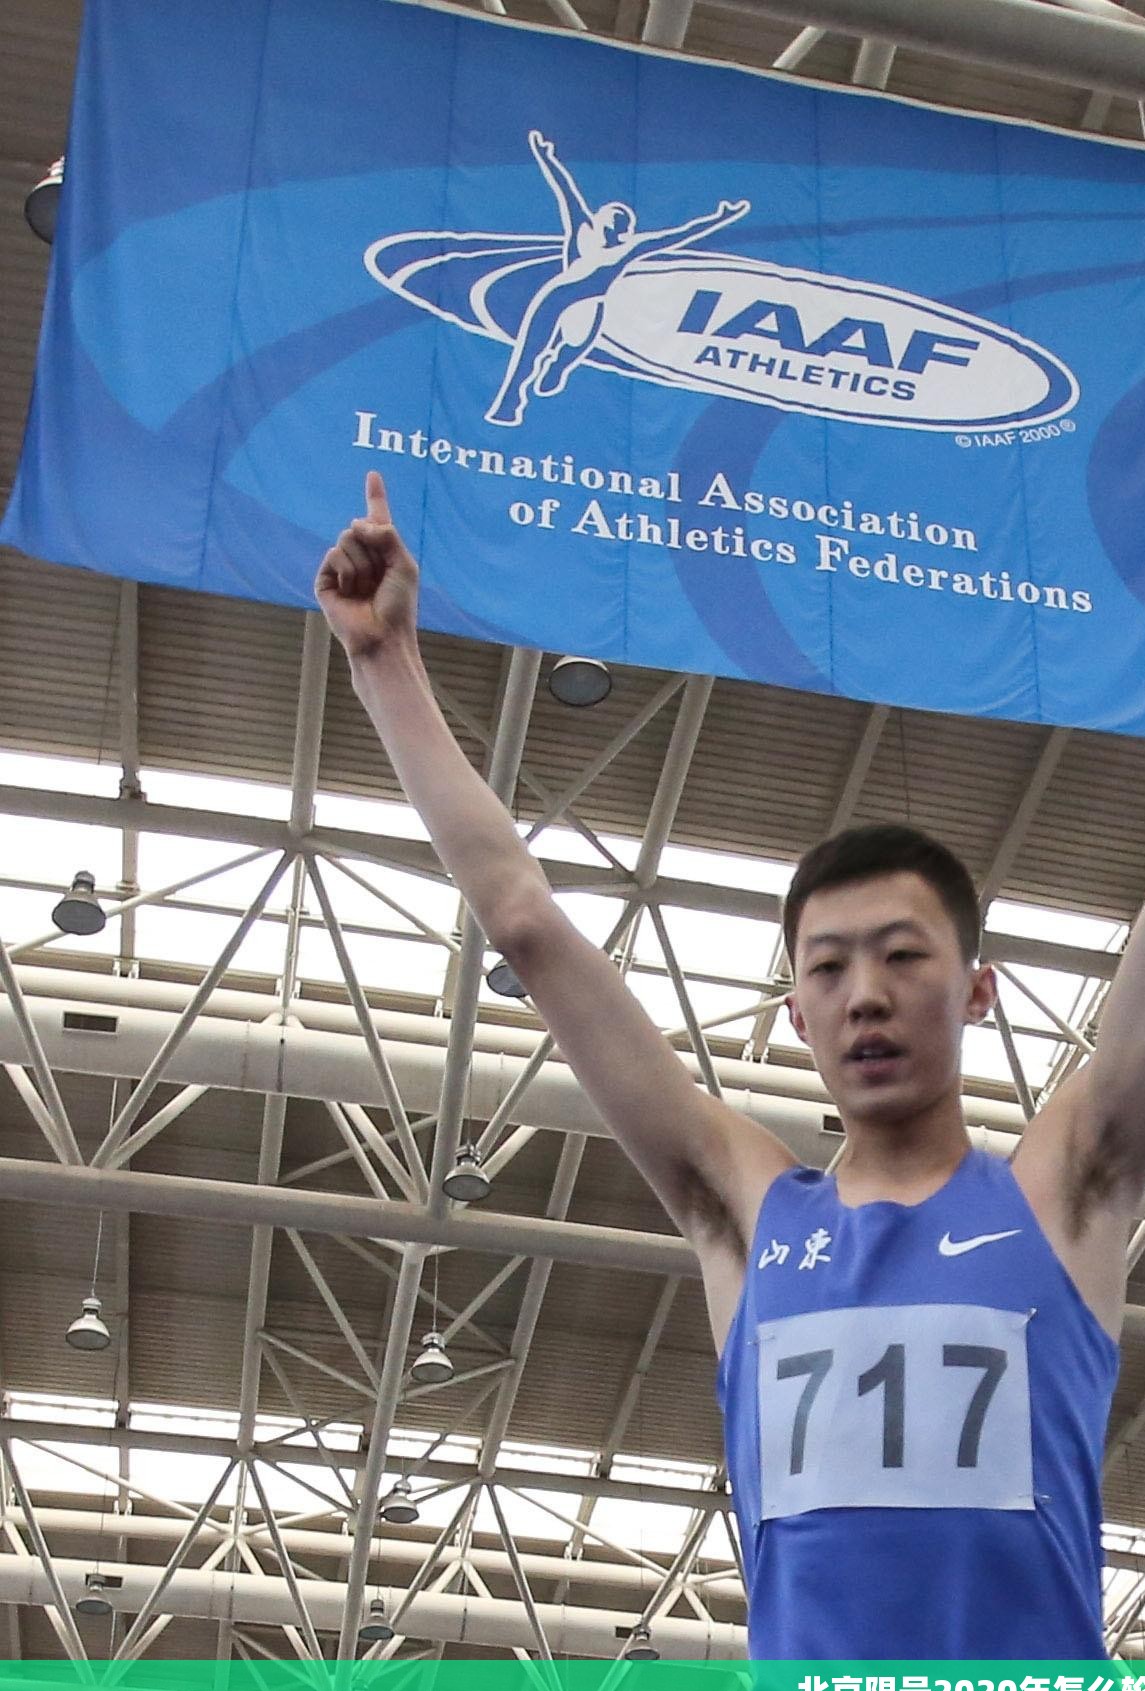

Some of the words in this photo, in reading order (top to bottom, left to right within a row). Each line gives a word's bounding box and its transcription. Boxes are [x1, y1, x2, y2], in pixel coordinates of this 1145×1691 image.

[677, 289, 980, 374] IAAF
[694, 345, 916, 401] ATHLETICS
[352, 411, 682, 502] International
[698, 472, 978, 551] Association
[974, 431, 1016, 447] IAAF
[509, 498, 560, 529] of
[571, 499, 797, 564] Athletics
[815, 534, 1093, 612] Federations
[776, 1343, 1008, 1476] 717
